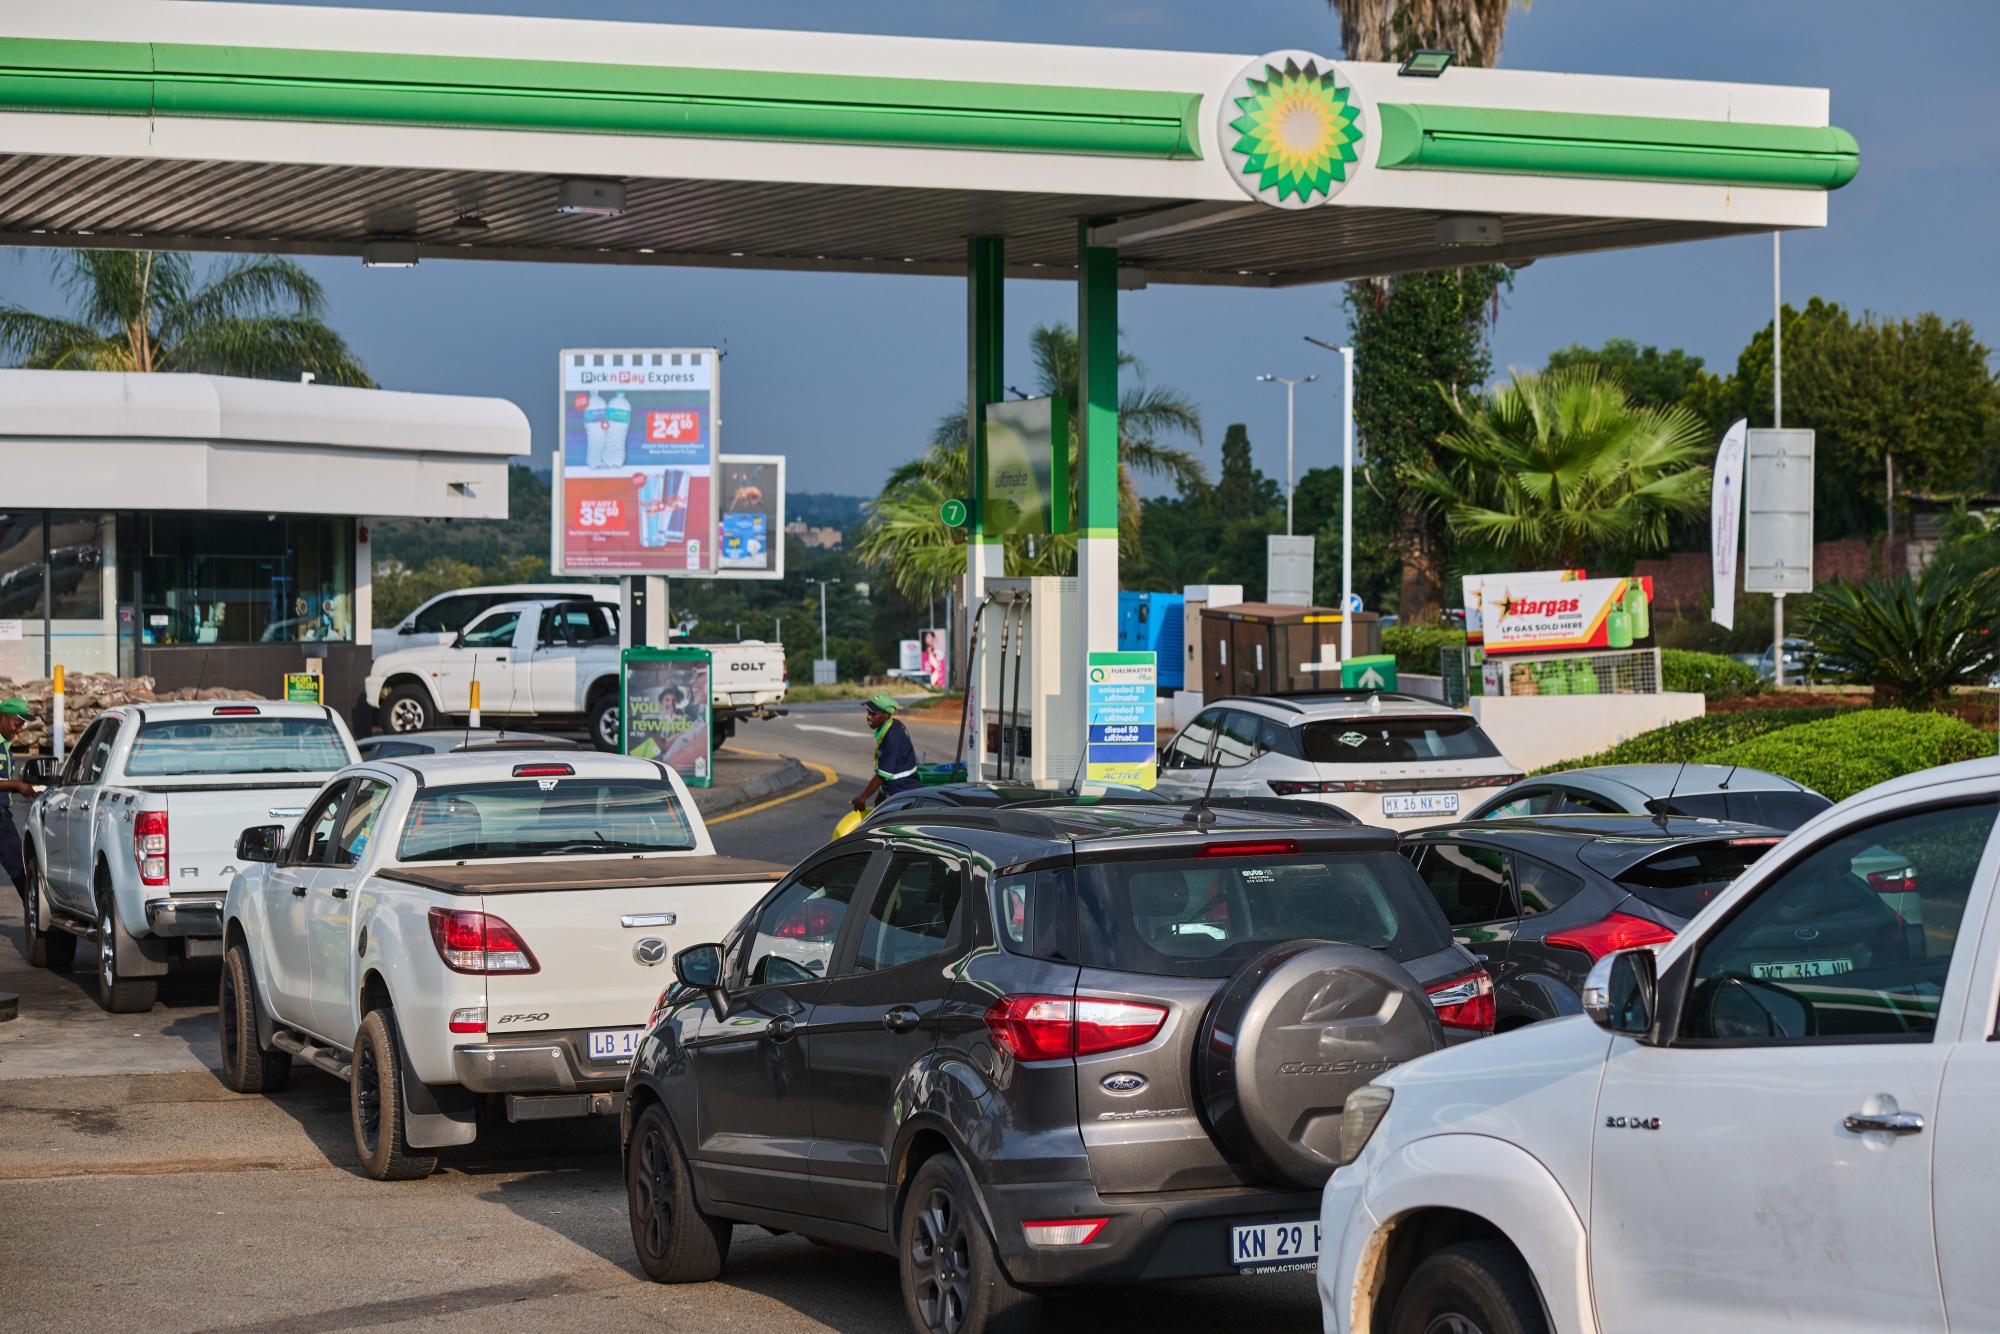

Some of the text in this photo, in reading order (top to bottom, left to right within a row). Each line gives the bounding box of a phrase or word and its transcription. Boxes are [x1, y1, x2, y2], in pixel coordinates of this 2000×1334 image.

[581, 371, 695, 385] Pick n Pay Express
[948, 505, 958, 520] 7
[1508, 598, 1580, 617] stargas
[1514, 624, 1533, 632] GAS
[1535, 623, 1559, 631] SOLD
[731, 662, 766, 671] COLT
[290, 675, 313, 684] scan
[1138, 673, 1152, 681] Plus
[1098, 686, 1134, 694] unleaded
[1104, 694, 1139, 702] ultimate
[630, 702, 659, 716] you
[1098, 706, 1134, 714] unleaded
[632, 716, 694, 731] rewards
[1104, 714, 1139, 722] ultimate
[1104, 734, 1139, 742] ultimate
[1404, 798, 1416, 810] 16
[1421, 797, 1433, 809] NX
[1444, 796, 1457, 808] GP
[497, 1012, 550, 1024] BT-50
[595, 1034, 615, 1054] LB
[1097, 1107, 1188, 1121] EcoSport
[1239, 1229, 1266, 1258] KN
[1277, 1226, 1303, 1256] 29
